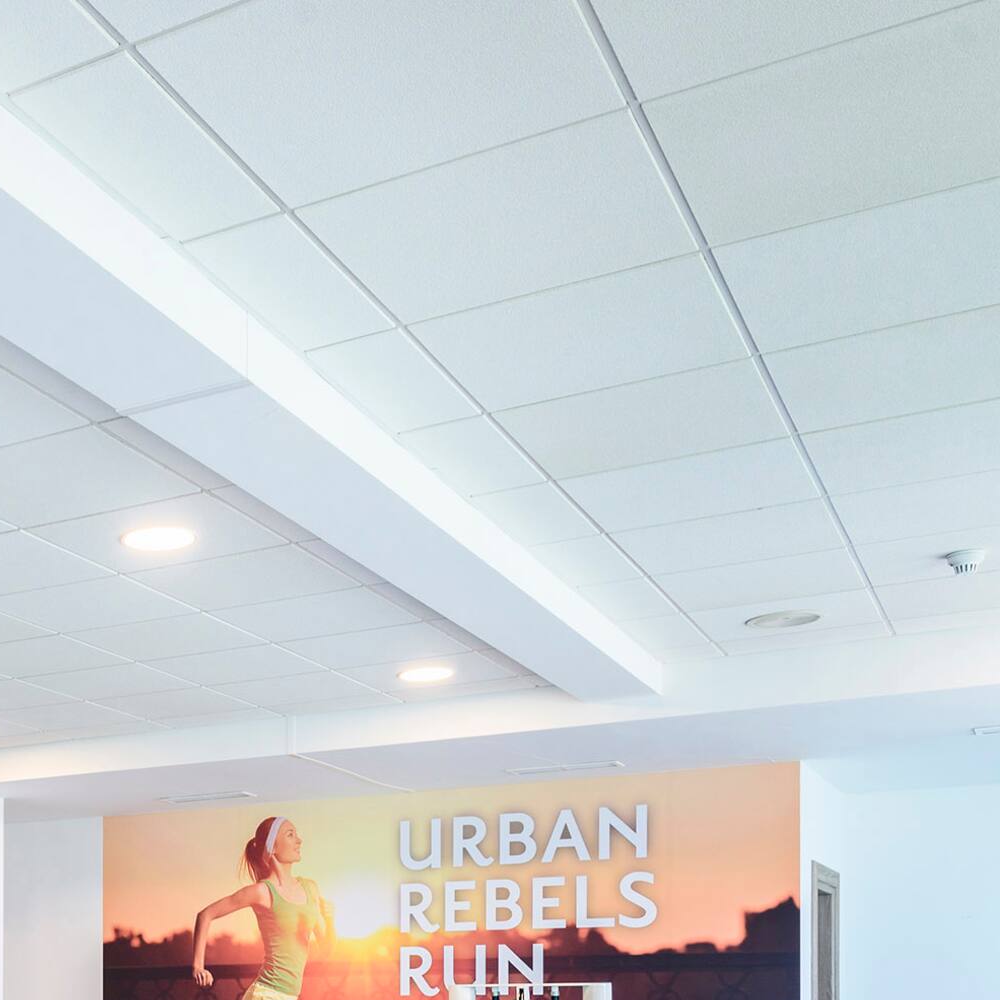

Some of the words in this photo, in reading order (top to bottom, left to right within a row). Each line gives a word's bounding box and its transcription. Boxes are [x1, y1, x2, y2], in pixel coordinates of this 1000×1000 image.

[399, 804, 648, 870] URBAN
[400, 871, 658, 933] REBELS
[400, 943, 544, 997] RUN
